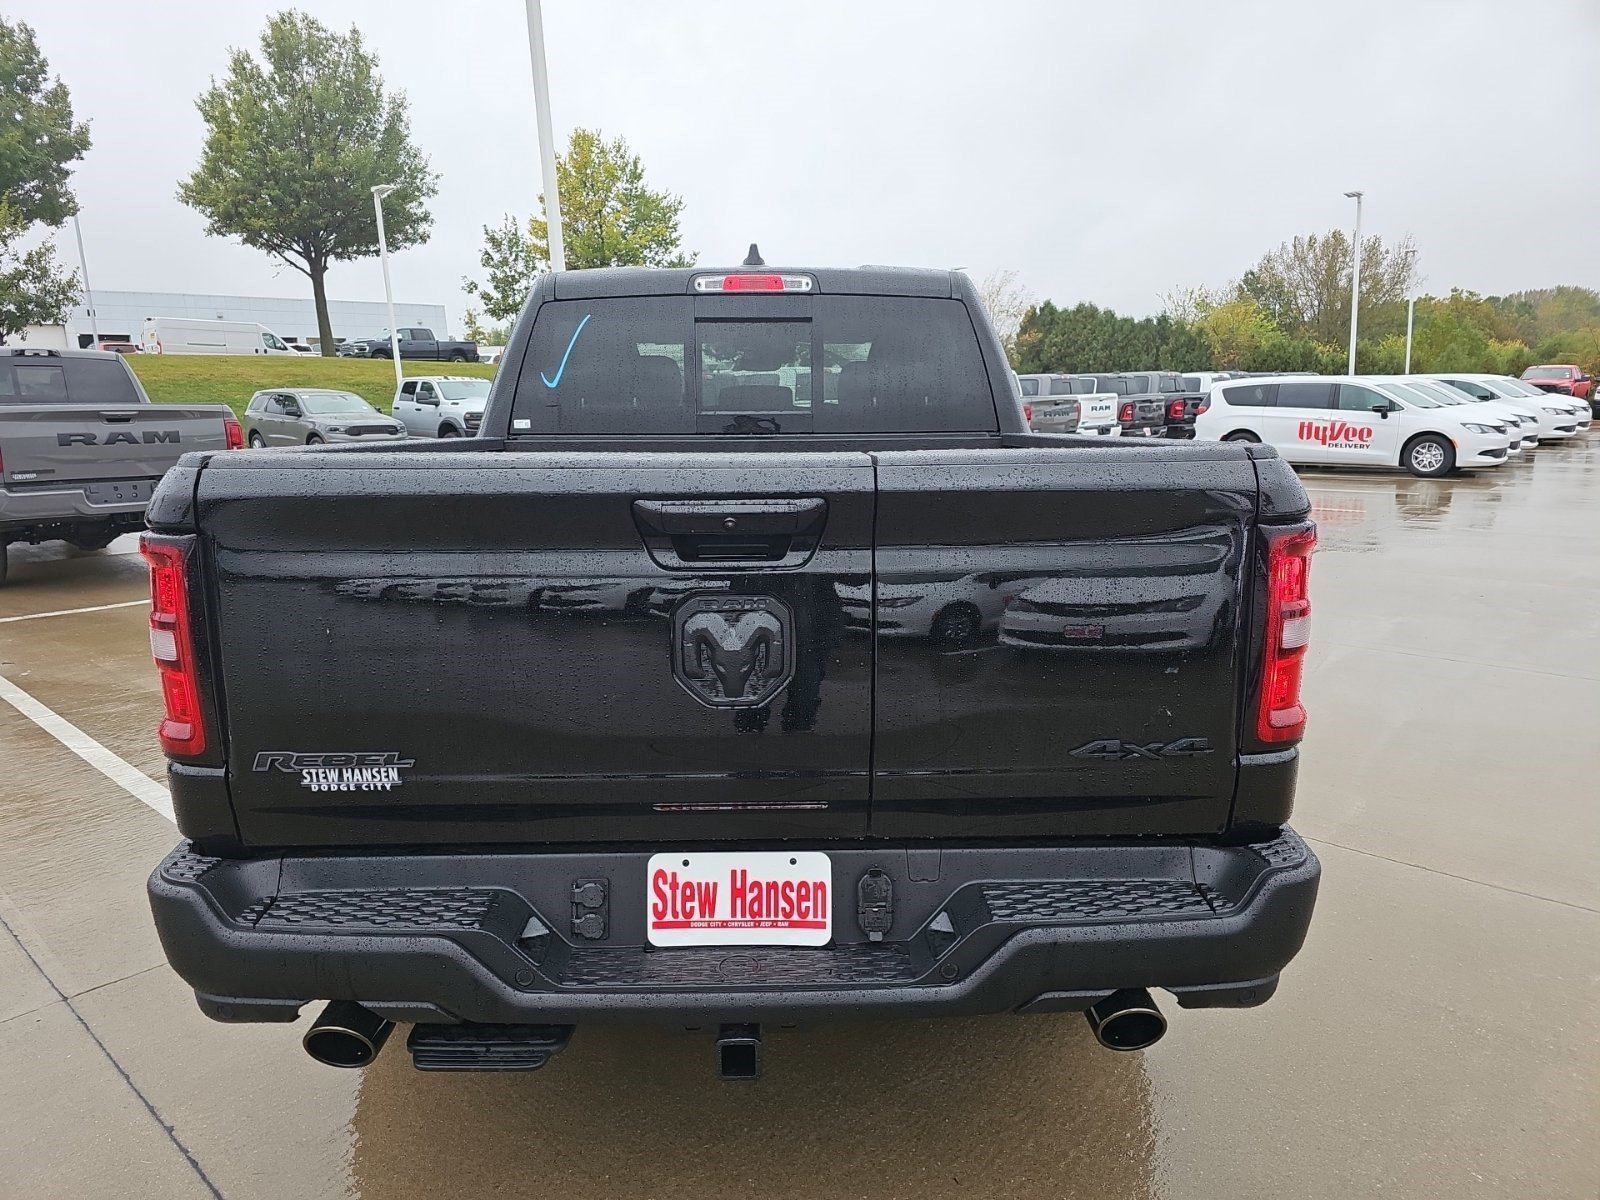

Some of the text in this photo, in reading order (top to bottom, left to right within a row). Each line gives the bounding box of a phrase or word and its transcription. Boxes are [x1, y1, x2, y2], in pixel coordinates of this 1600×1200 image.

[1043, 409, 1070, 418] RAM
[56, 430, 181, 447] RAM
[1327, 442, 1371, 450] DELIVERY
[698, 599, 769, 609] RAM
[252, 752, 415, 773] REBEL
[302, 768, 398, 783] STEW HANSEN
[311, 783, 392, 792] DODGE CITY
[652, 868, 827, 921] Stew Hansen
